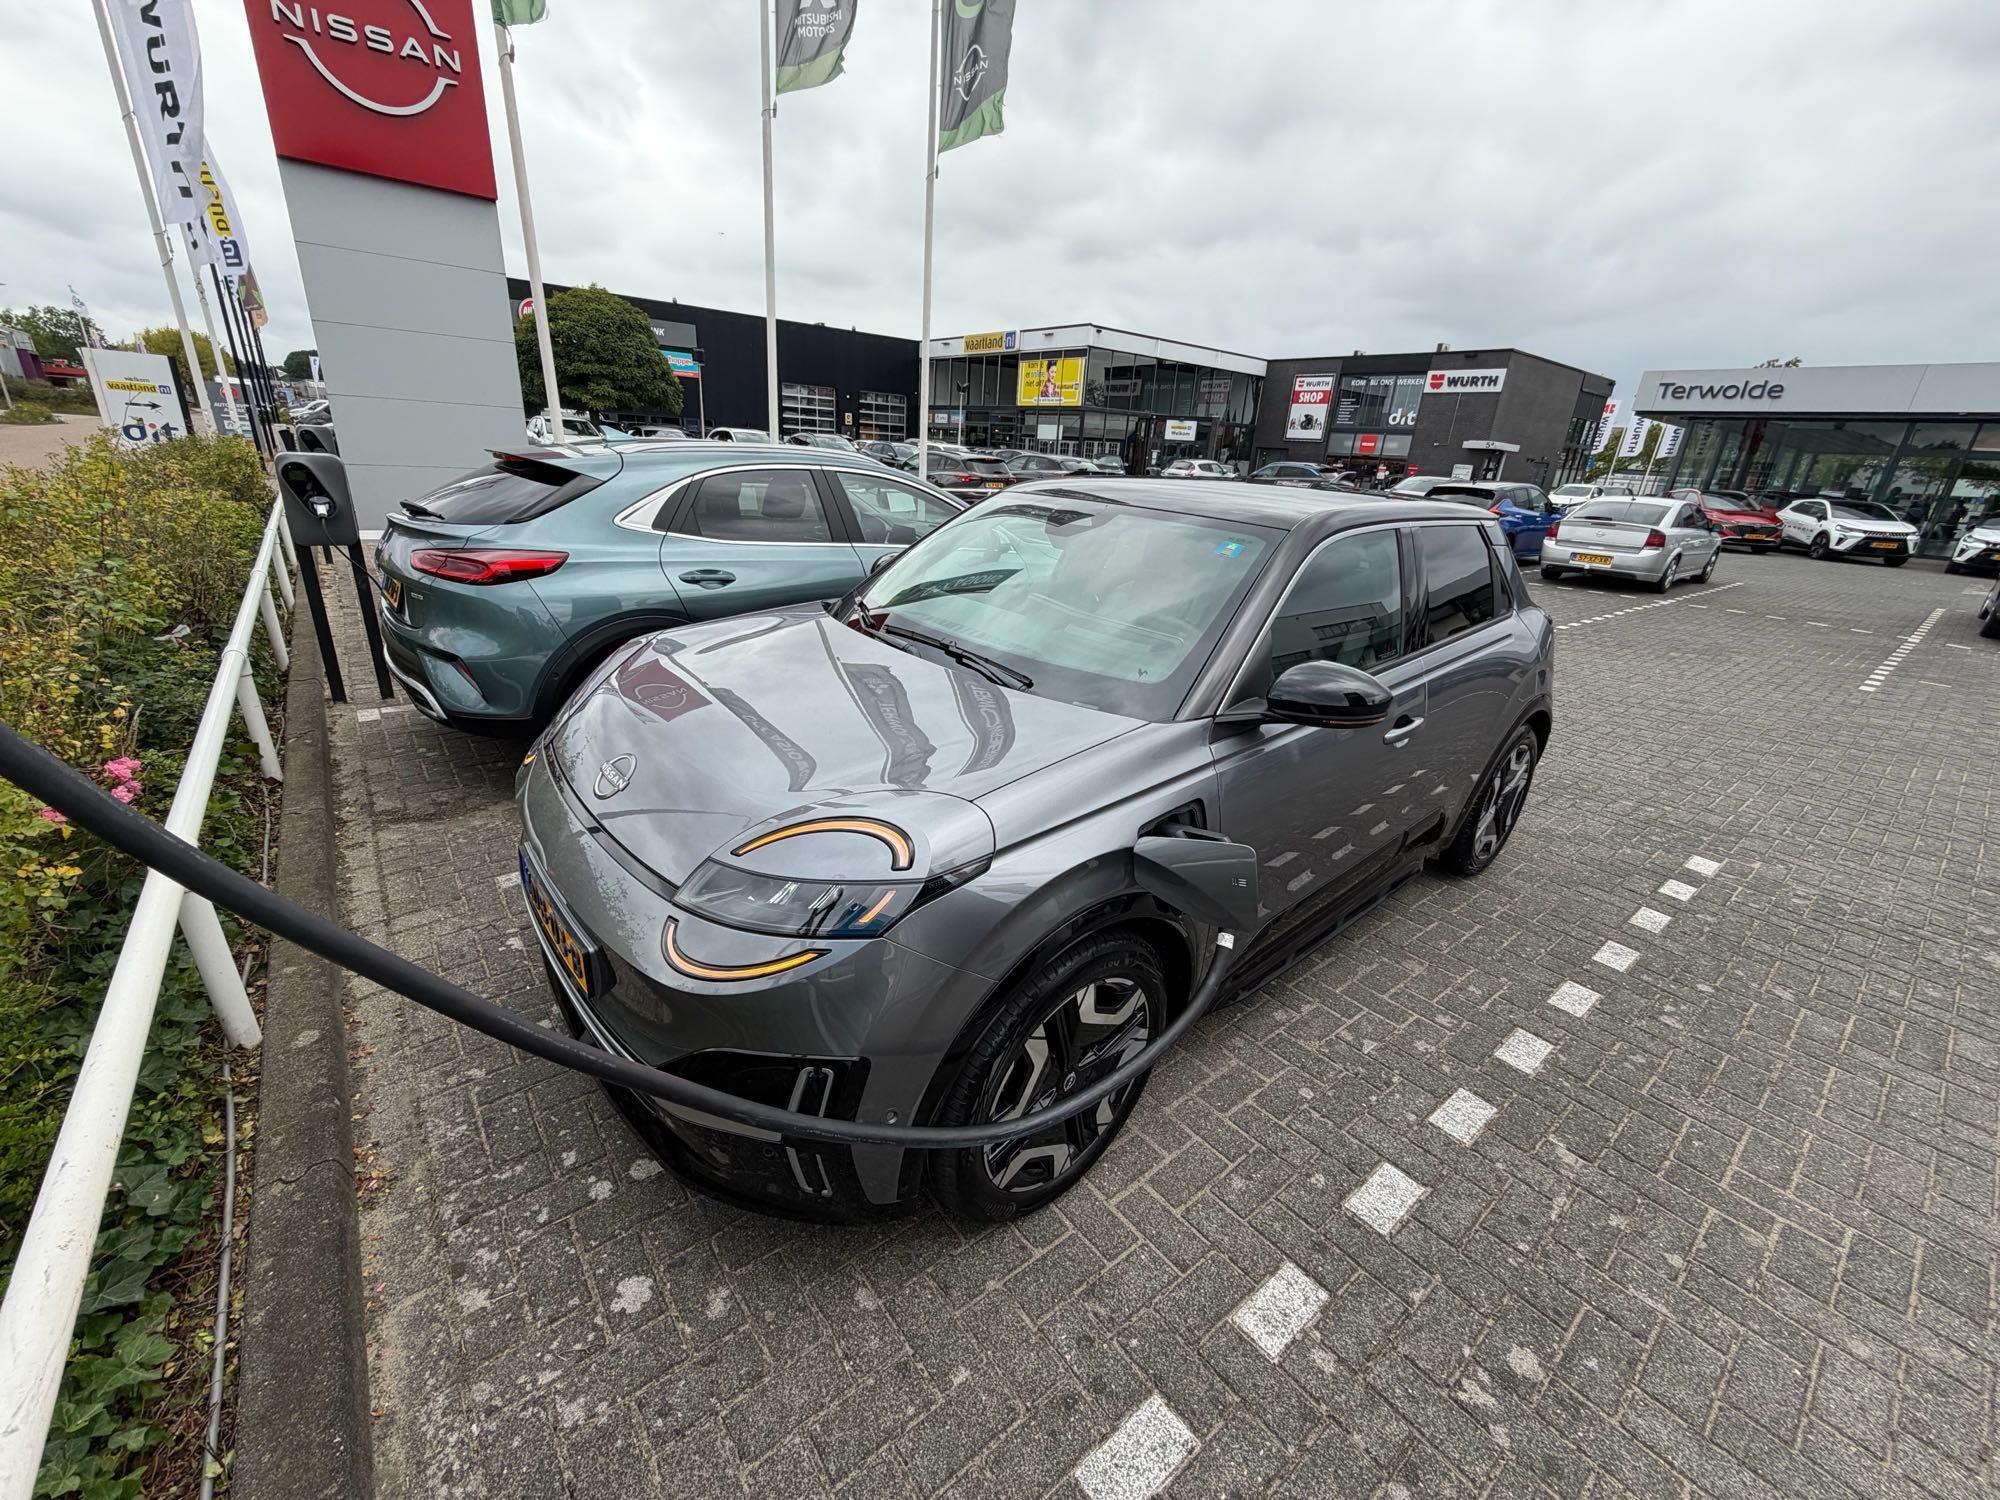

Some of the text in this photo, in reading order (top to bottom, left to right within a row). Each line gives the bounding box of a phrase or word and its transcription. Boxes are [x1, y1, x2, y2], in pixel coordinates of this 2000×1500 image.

[794, 10, 842, 28] MITSUBISHI
[270, 0, 462, 73] NISSAN
[954, 60, 988, 85] NISSAN
[1396, 378, 1424, 386] WERKEN
[1659, 380, 1785, 400] Terwolde
[1298, 391, 1324, 403] SHOP
[1388, 408, 1417, 426] dit
[122, 418, 179, 443] dit
[602, 762, 627, 790] NISSAN
